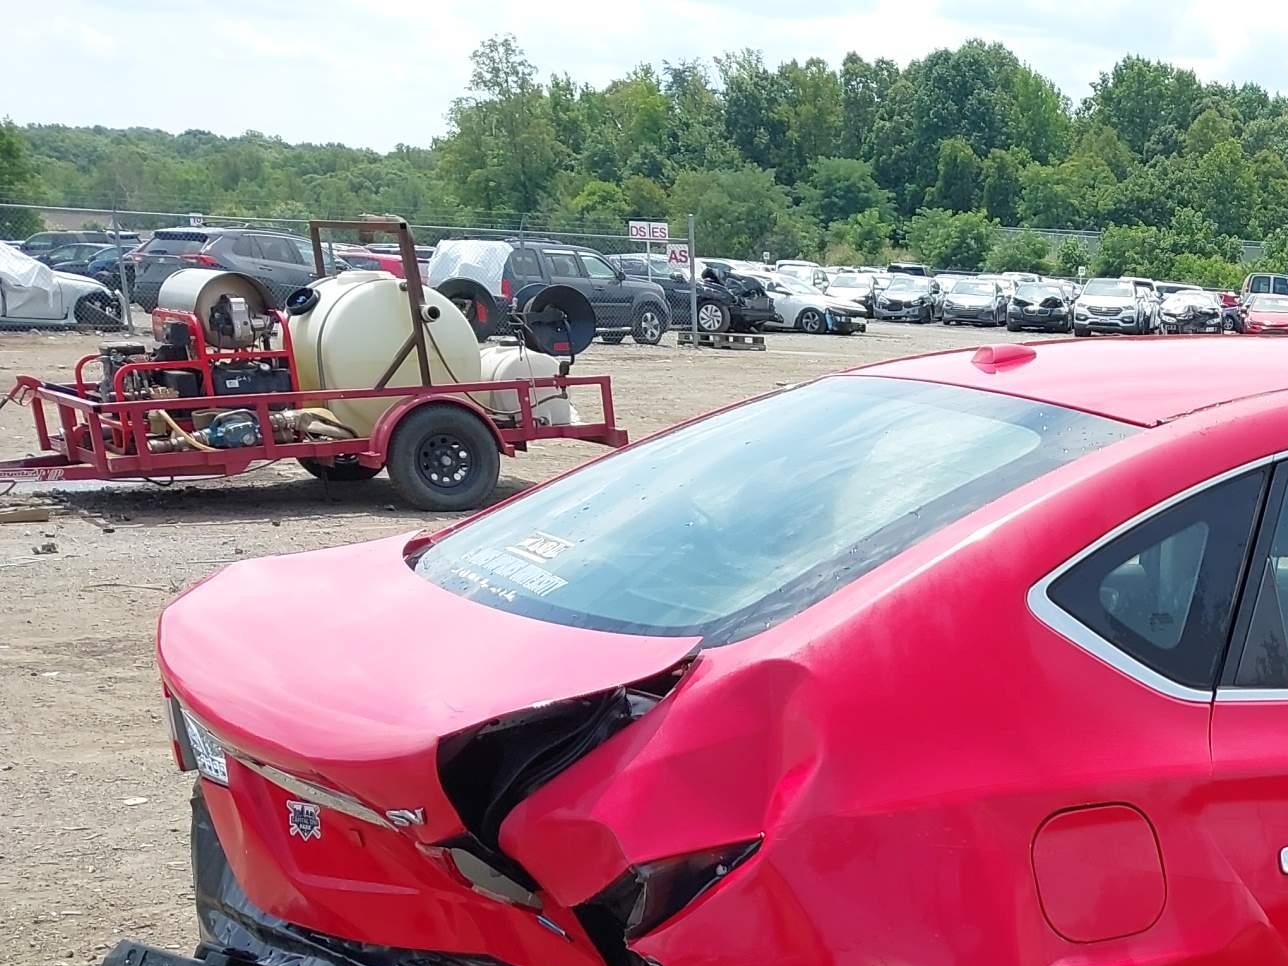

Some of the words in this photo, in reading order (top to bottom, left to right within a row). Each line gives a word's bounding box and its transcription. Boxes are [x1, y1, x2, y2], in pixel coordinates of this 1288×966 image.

[630, 226, 647, 237] DS
[651, 226, 667, 238] ES
[668, 250, 688, 263] AS
